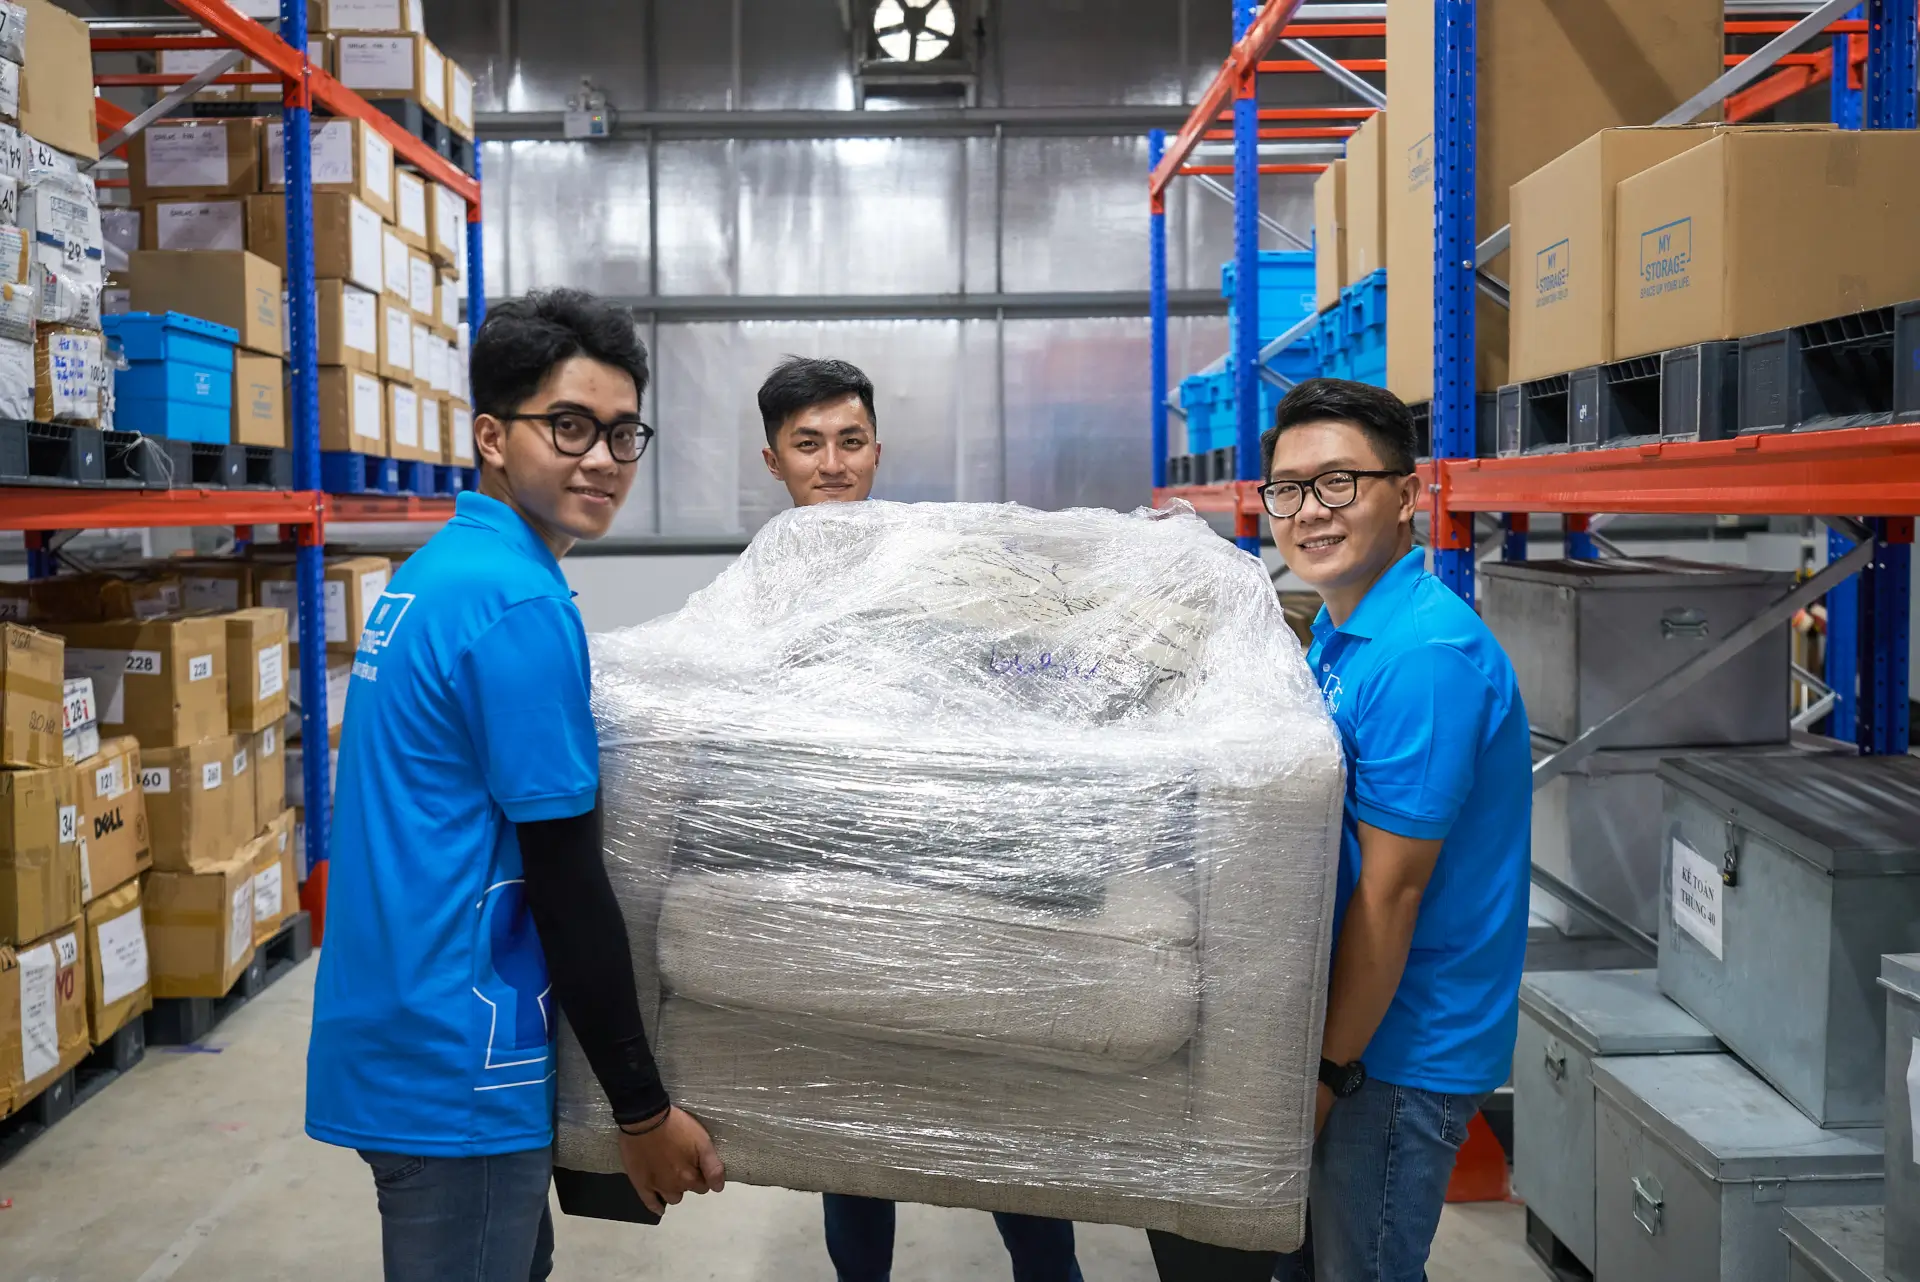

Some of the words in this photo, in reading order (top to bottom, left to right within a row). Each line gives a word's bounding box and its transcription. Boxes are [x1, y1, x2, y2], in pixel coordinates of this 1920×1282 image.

[1658, 233, 1671, 254] MY
[1645, 252, 1686, 282] STORAGE
[126, 656, 153, 671] 228
[192, 661, 208, 677] 228
[62, 813, 73, 836] 34
[94, 807, 124, 840] DELL
[1707, 911, 1716, 926] 40
